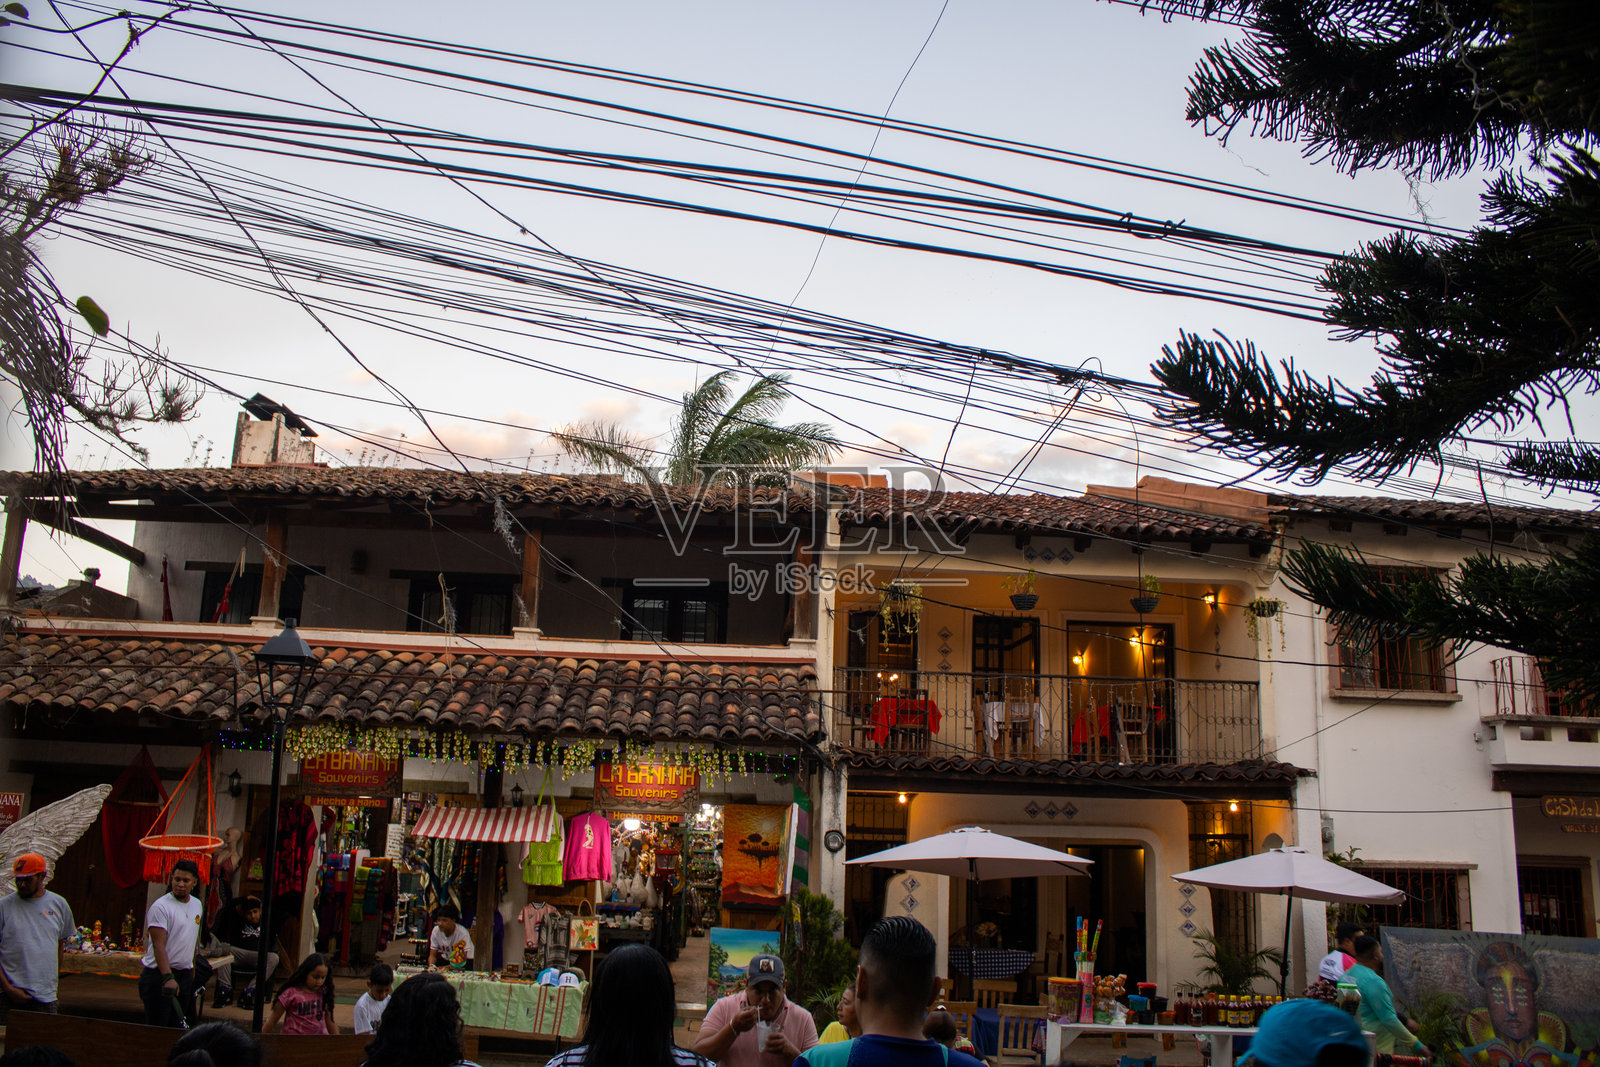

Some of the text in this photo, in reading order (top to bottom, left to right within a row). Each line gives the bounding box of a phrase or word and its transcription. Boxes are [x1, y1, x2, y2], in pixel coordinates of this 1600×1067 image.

[304, 751, 399, 771] LA BANANA
[318, 772, 379, 784] Souvenirs
[600, 764, 695, 785] LA BANANA
[615, 784, 678, 799] Souvenirs
[316, 797, 347, 807] Hecho
[349, 799, 355, 807] a
[1580, 800, 1593, 817] de
[613, 811, 643, 821] Hecho
